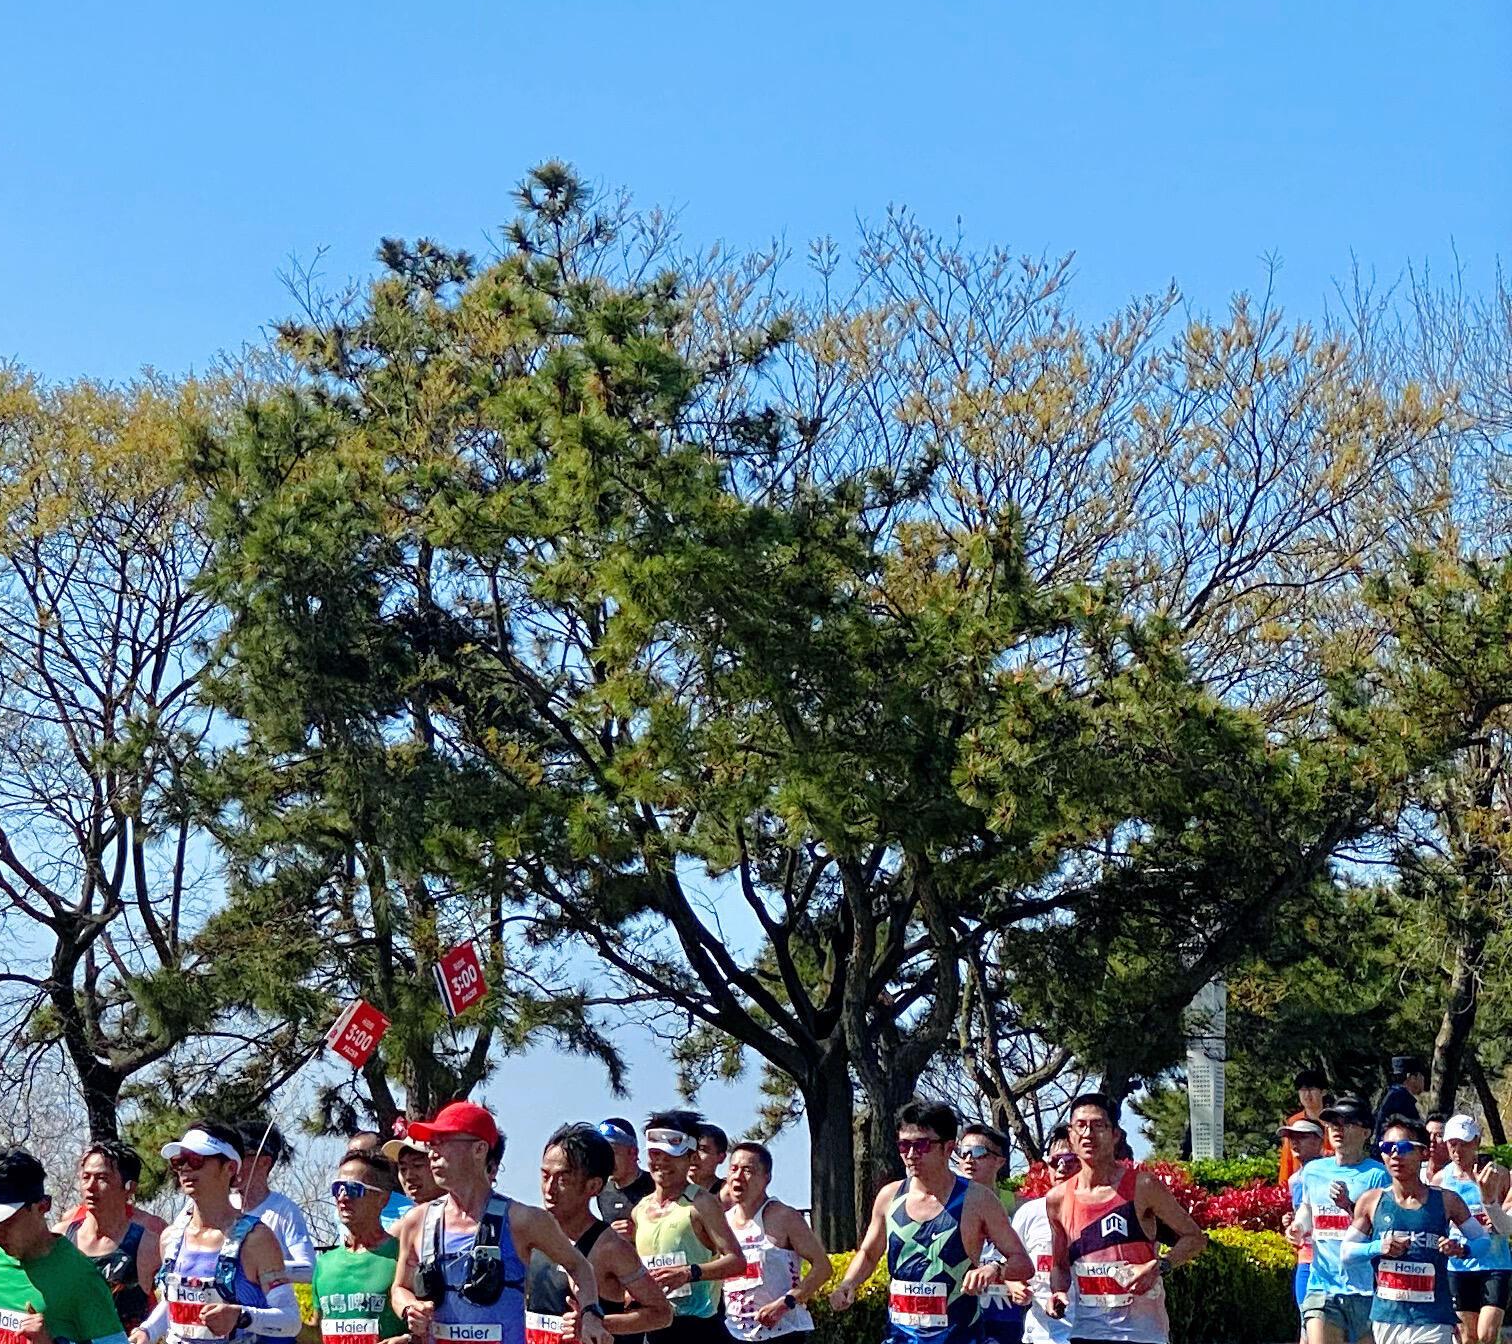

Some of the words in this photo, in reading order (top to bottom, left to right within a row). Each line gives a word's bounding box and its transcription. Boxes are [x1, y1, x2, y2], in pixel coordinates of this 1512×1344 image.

[451, 964, 477, 995] 3:00
[345, 1024, 373, 1052] 3:00
[342, 1045, 359, 1058] PACER
[1394, 1262, 1427, 1274] Haier
[904, 1284, 937, 1295] Haier
[335, 1321, 368, 1333] Haier
[449, 1326, 490, 1340] Haier
